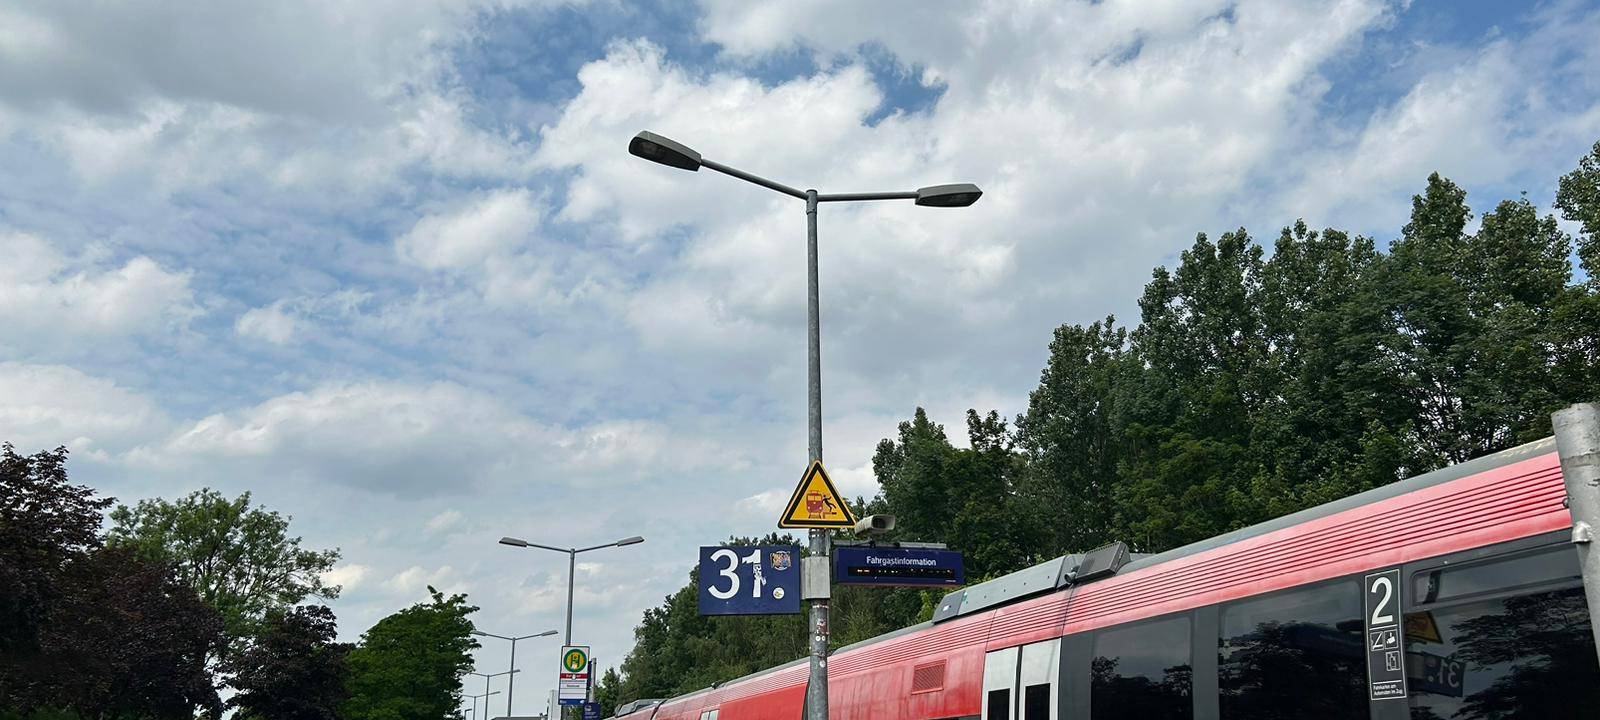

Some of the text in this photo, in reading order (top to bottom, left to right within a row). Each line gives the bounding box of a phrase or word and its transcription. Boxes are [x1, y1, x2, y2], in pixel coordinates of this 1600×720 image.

[707, 549, 762, 600] 31
[866, 556, 937, 567] Fahrgastinformation
[1370, 576, 1394, 625] 2
[571, 654, 580, 668] H
